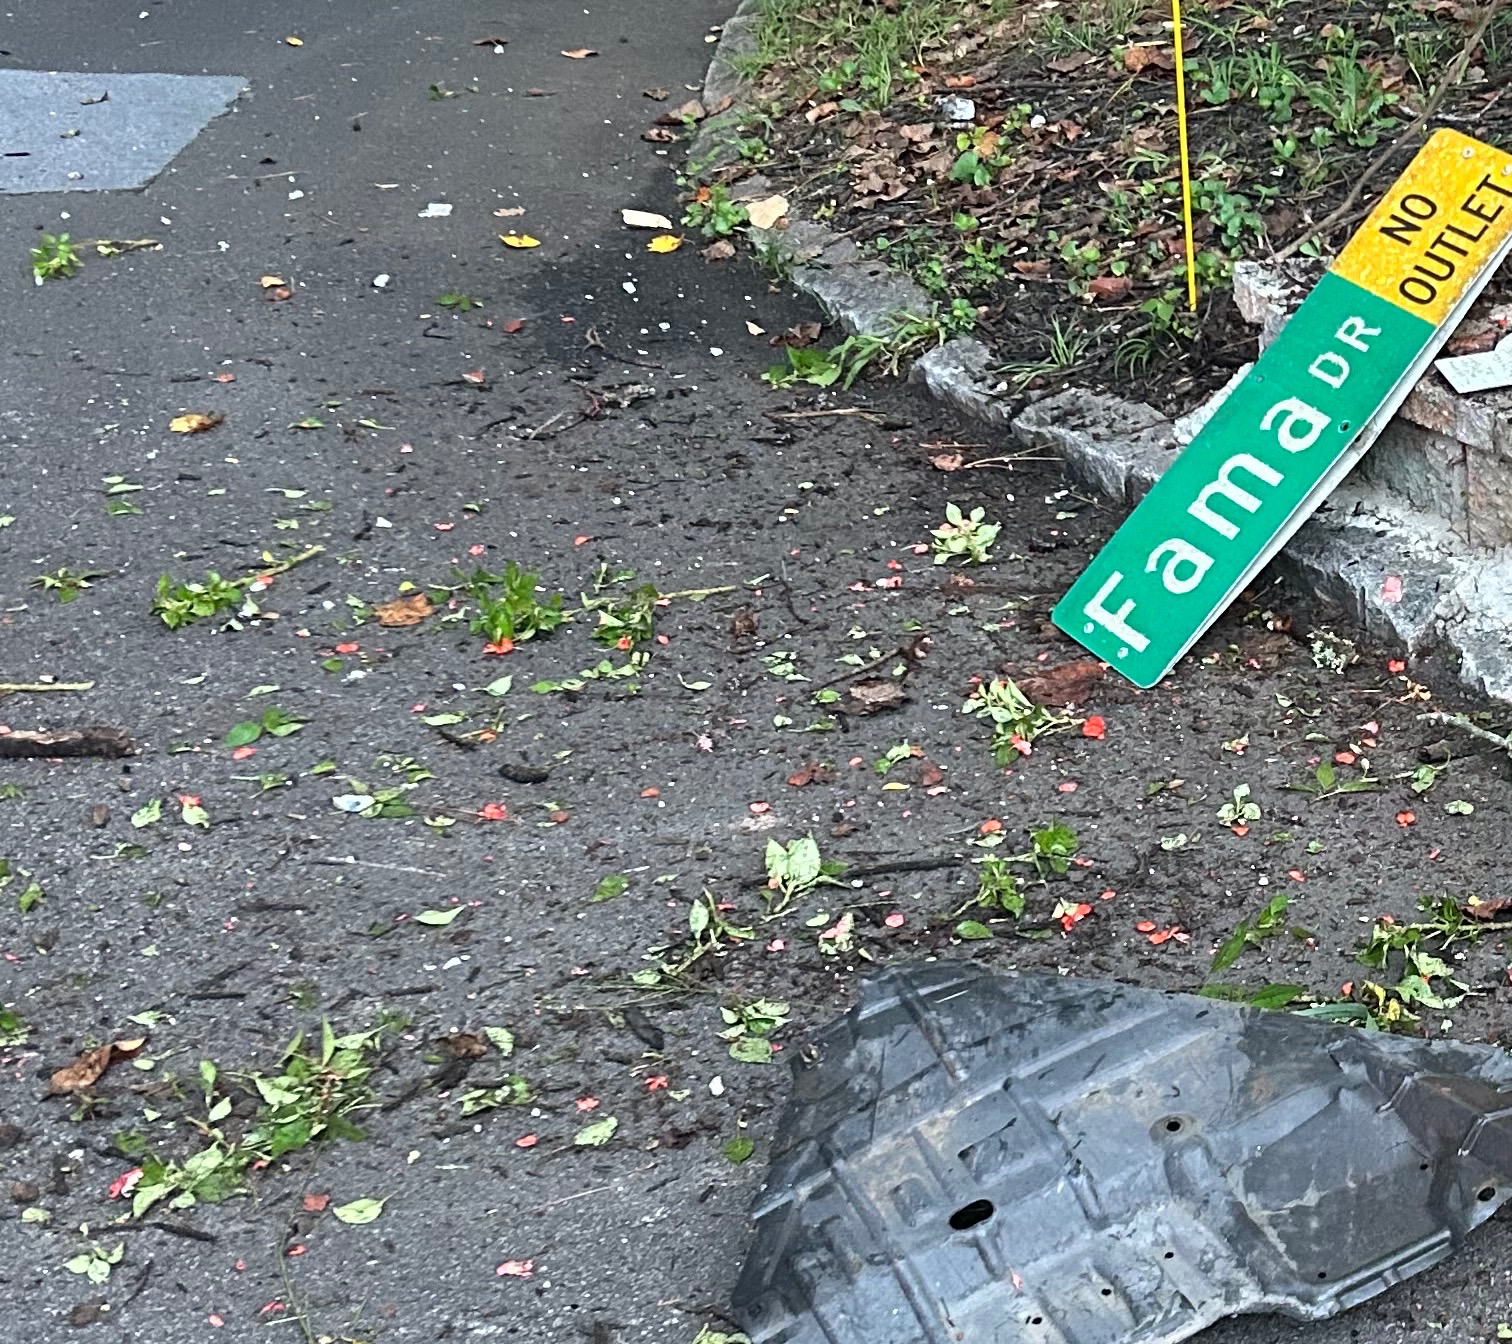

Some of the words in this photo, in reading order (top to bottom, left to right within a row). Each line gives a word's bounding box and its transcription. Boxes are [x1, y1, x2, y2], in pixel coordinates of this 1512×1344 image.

[1379, 192, 1438, 248] NO
[1082, 394, 1332, 654] Fama
[1307, 314, 1383, 390] DR
